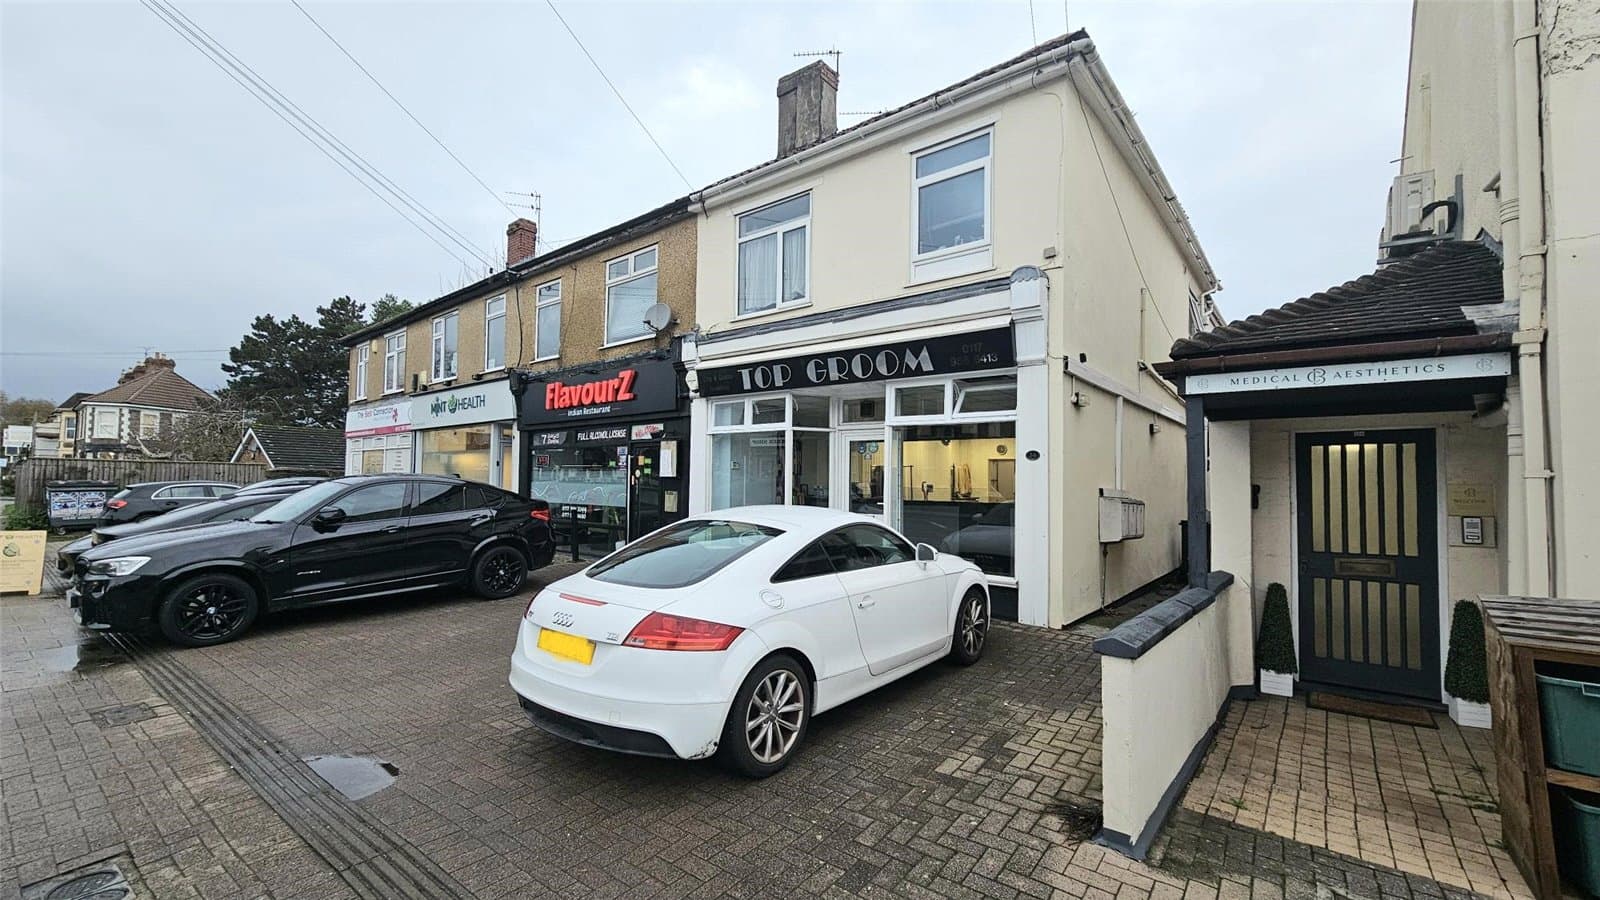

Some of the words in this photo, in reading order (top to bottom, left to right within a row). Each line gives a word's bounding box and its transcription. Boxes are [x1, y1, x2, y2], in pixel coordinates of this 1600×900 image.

[736, 363, 792, 390] TOP
[806, 345, 935, 384] GROOM
[1230, 374, 1301, 386] MEDICAL
[1333, 363, 1446, 380] AESTHETICS
[545, 369, 635, 410] FlavourZ
[430, 396, 447, 417] MINT
[458, 394, 486, 411] HEALTH
[567, 408, 583, 417] Indian
[583, 405, 612, 415] Restaurant
[541, 434, 547, 445] 7
[577, 431, 589, 441] FULL
[589, 430, 609, 440] ALCOHOL
[609, 429, 627, 439] LICENSE
